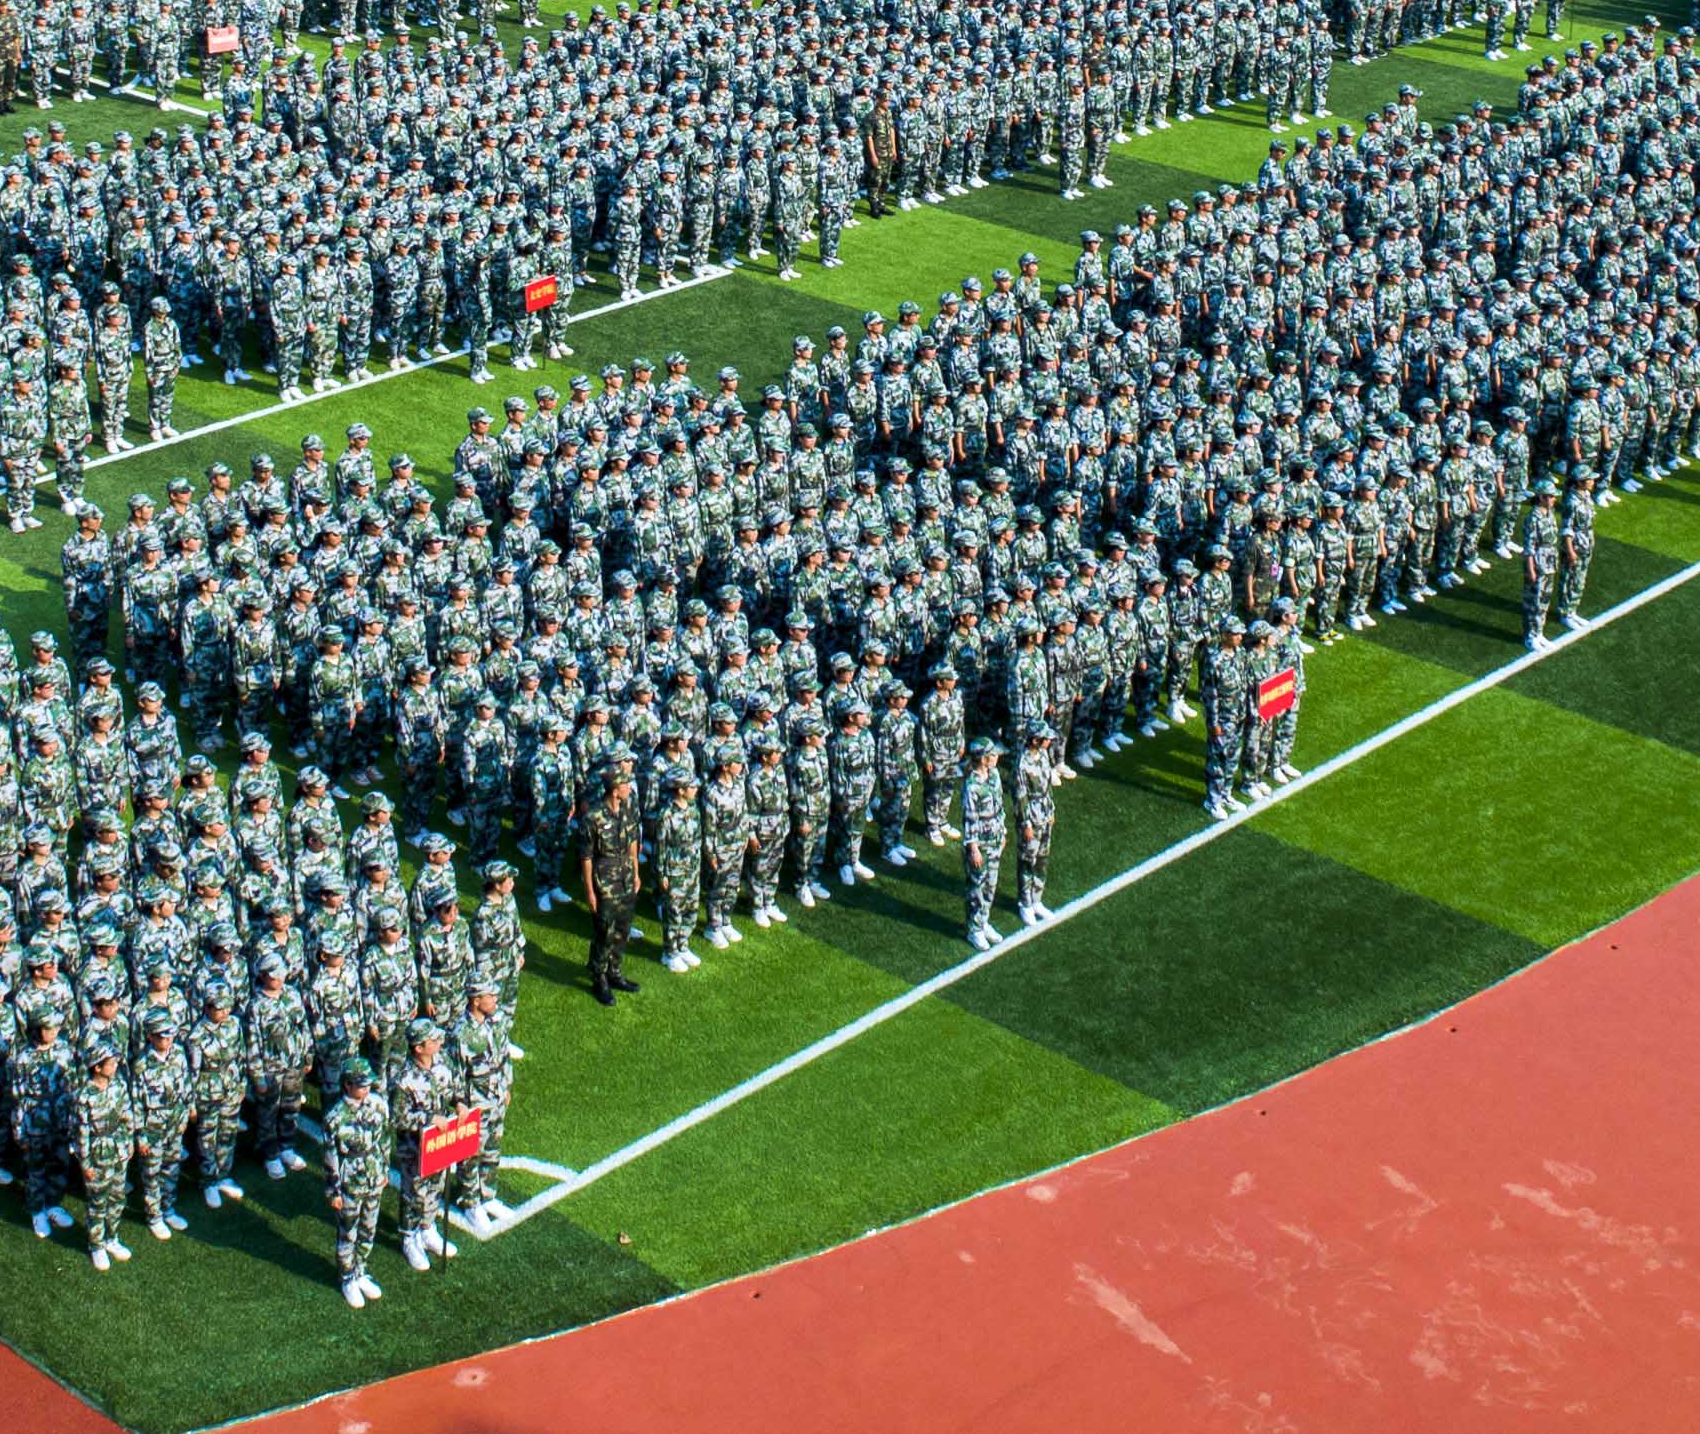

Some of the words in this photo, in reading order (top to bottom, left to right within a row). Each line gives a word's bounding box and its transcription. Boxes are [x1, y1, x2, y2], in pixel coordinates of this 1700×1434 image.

[426, 1121, 478, 1154] 外国语学院
